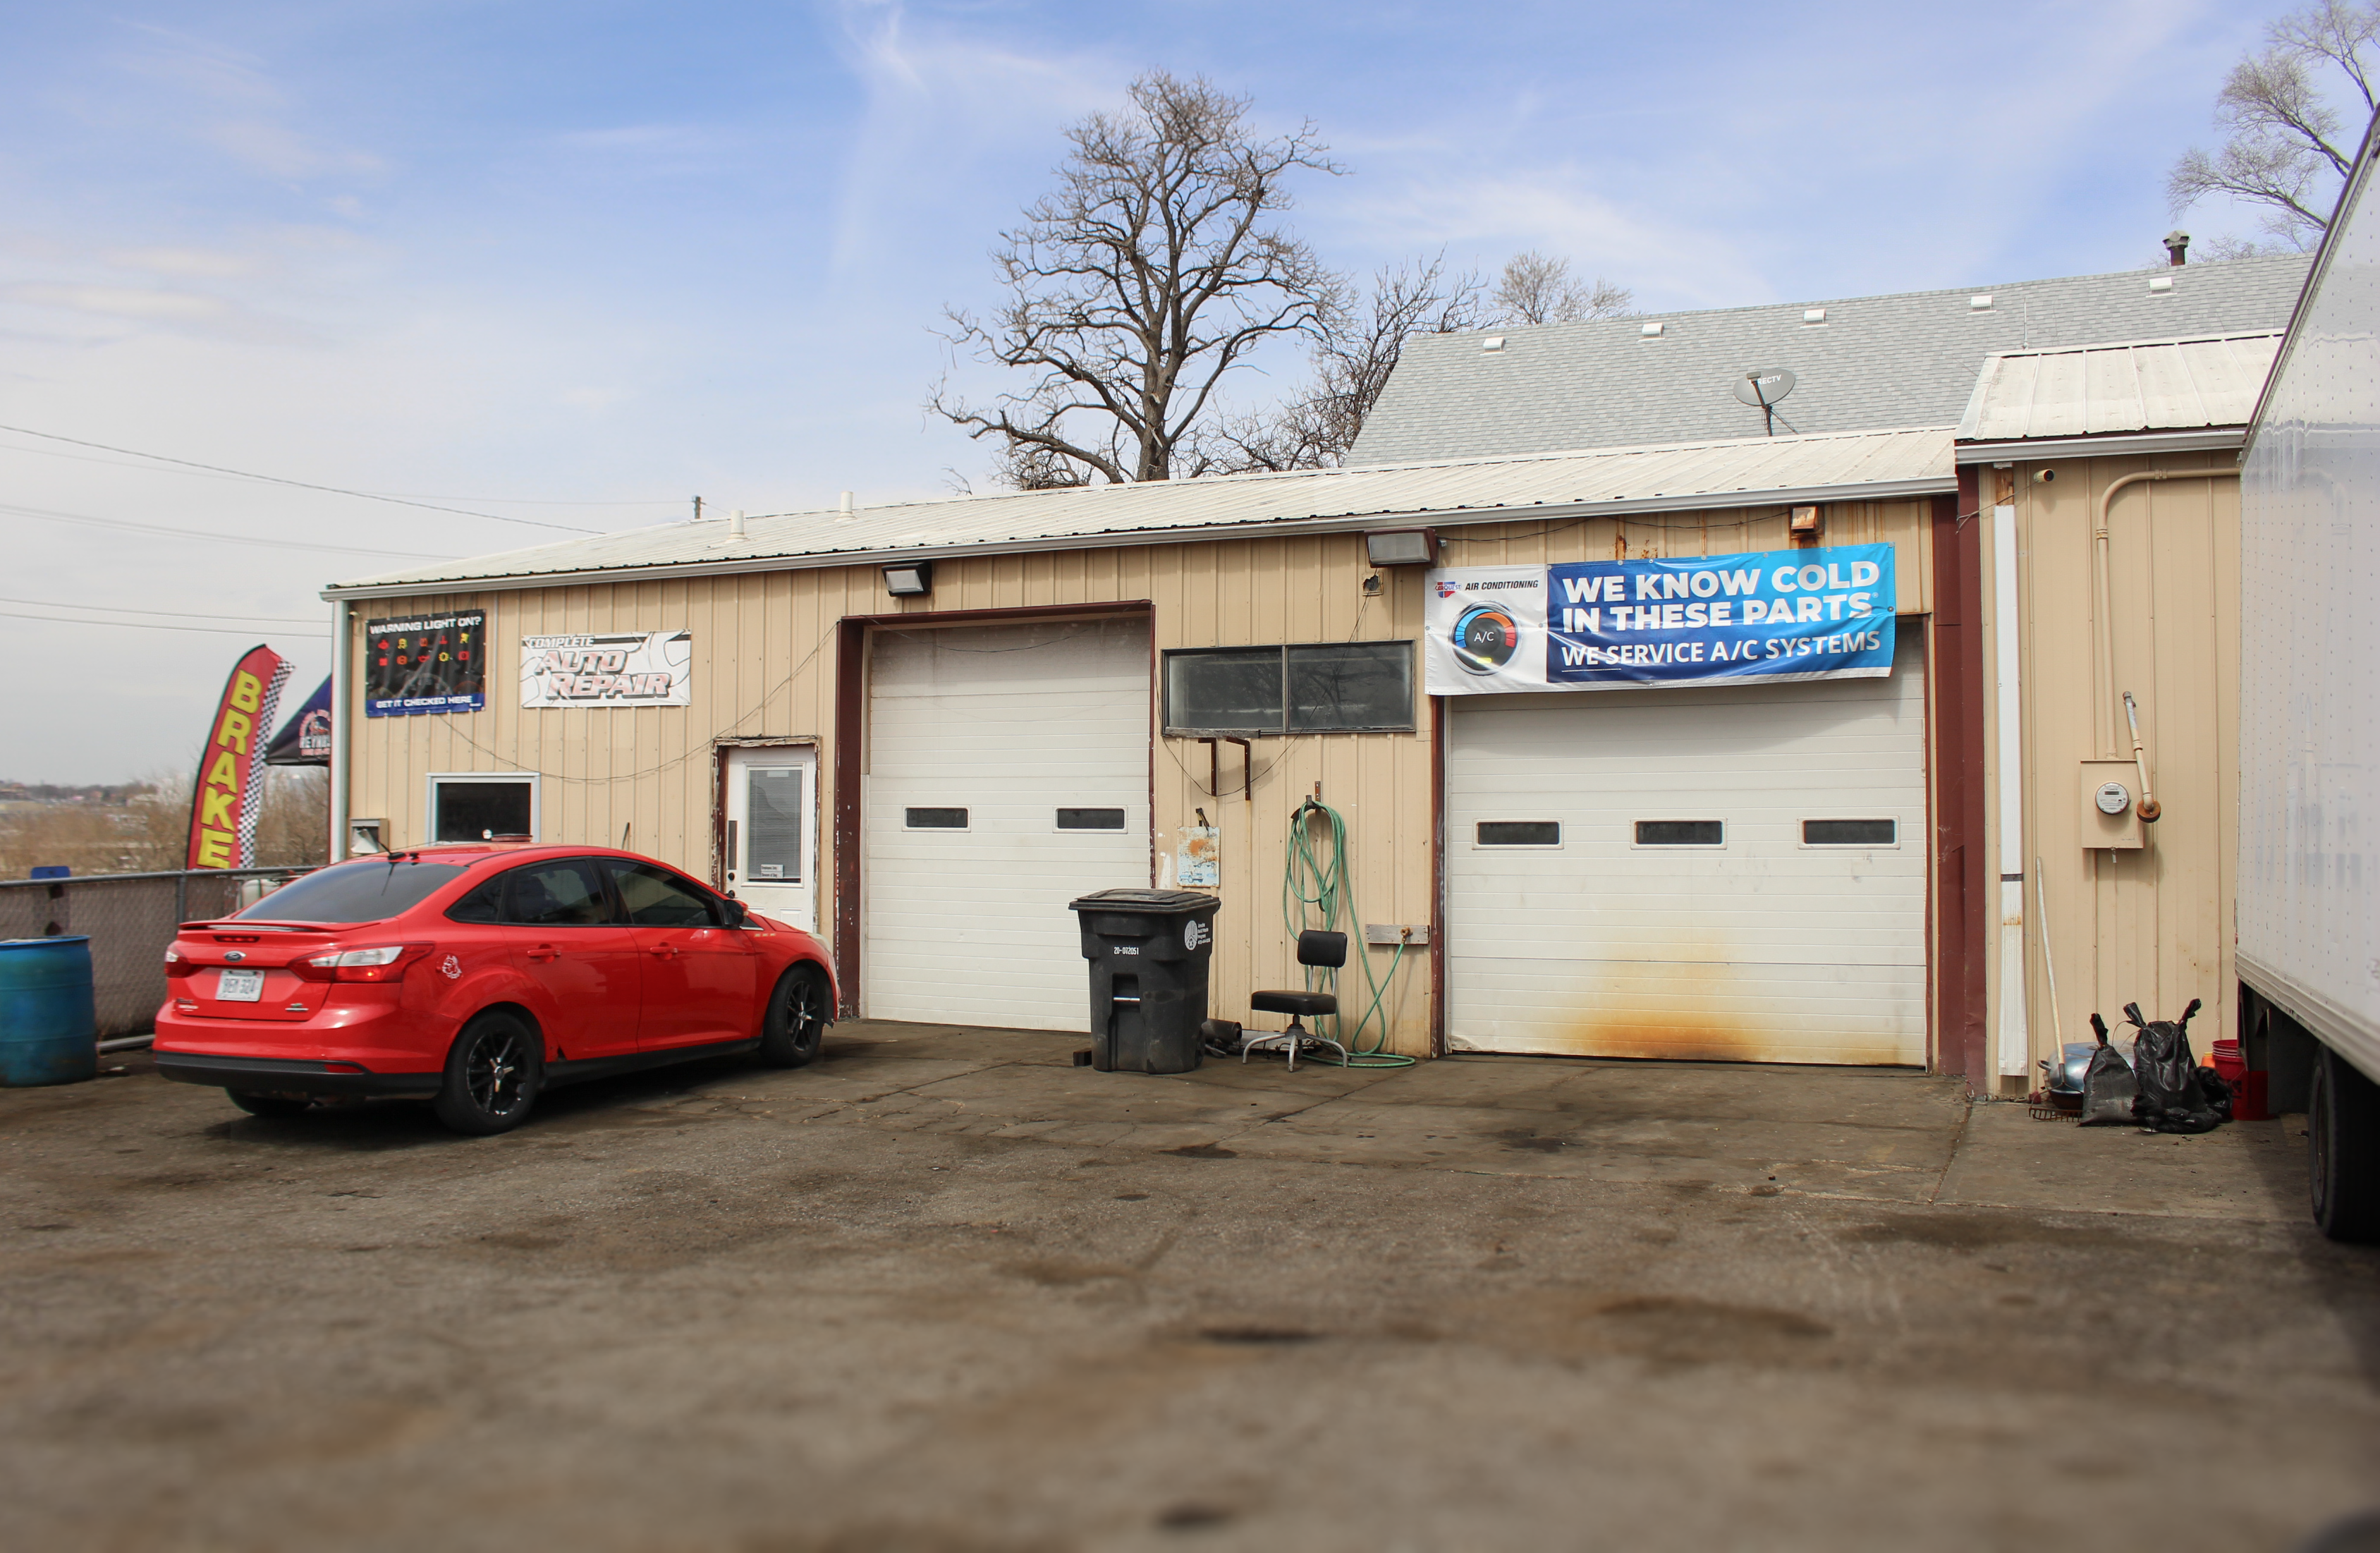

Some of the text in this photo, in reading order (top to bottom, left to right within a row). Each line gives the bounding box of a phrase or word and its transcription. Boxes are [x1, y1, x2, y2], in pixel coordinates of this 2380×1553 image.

[1749, 374, 1781, 386] RECTV
[1465, 580, 1539, 591] AIR CONDITIONING
[1562, 561, 1880, 604] WE KNOW COLD
[1562, 592, 1873, 634] IN THESE PARTS
[369, 616, 482, 635] WARNING LIGHT ON?
[527, 635, 594, 649] COMPLETE
[1474, 631, 1494, 643] A/C
[1561, 631, 1881, 666] WE SERVICE A/C SYSTEMS
[535, 650, 628, 675] AUTO
[546, 672, 672, 699] REPAIR
[376, 700, 393, 709] GET
[393, 699, 403, 707] IT
[403, 697, 446, 707] CHECKED
[447, 695, 472, 704] HERE
